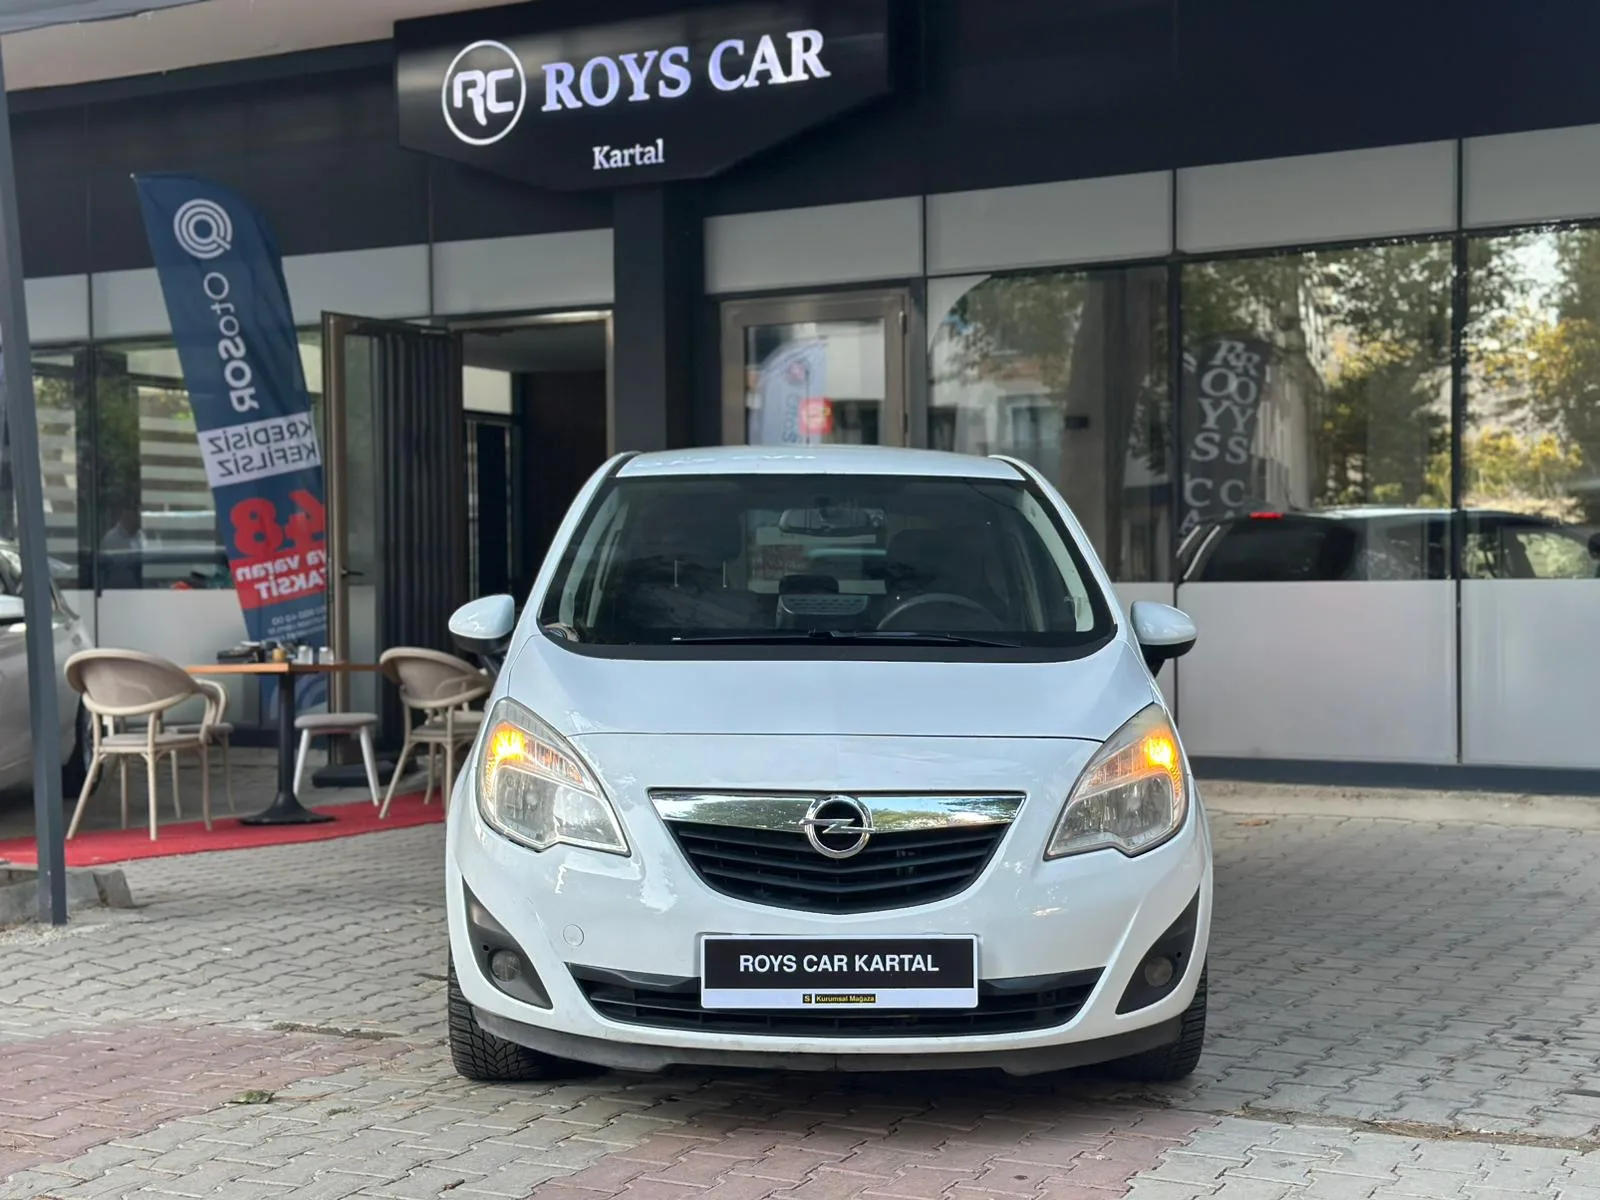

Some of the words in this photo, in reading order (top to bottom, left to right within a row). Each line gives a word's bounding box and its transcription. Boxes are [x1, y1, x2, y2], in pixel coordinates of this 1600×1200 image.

[541, 47, 692, 112] ROYS
[708, 29, 831, 92] CAR
[592, 139, 665, 170] Kartal
[739, 954, 797, 973] ROYS
[803, 954, 848, 973] CAR
[855, 954, 940, 973] KARTAL
